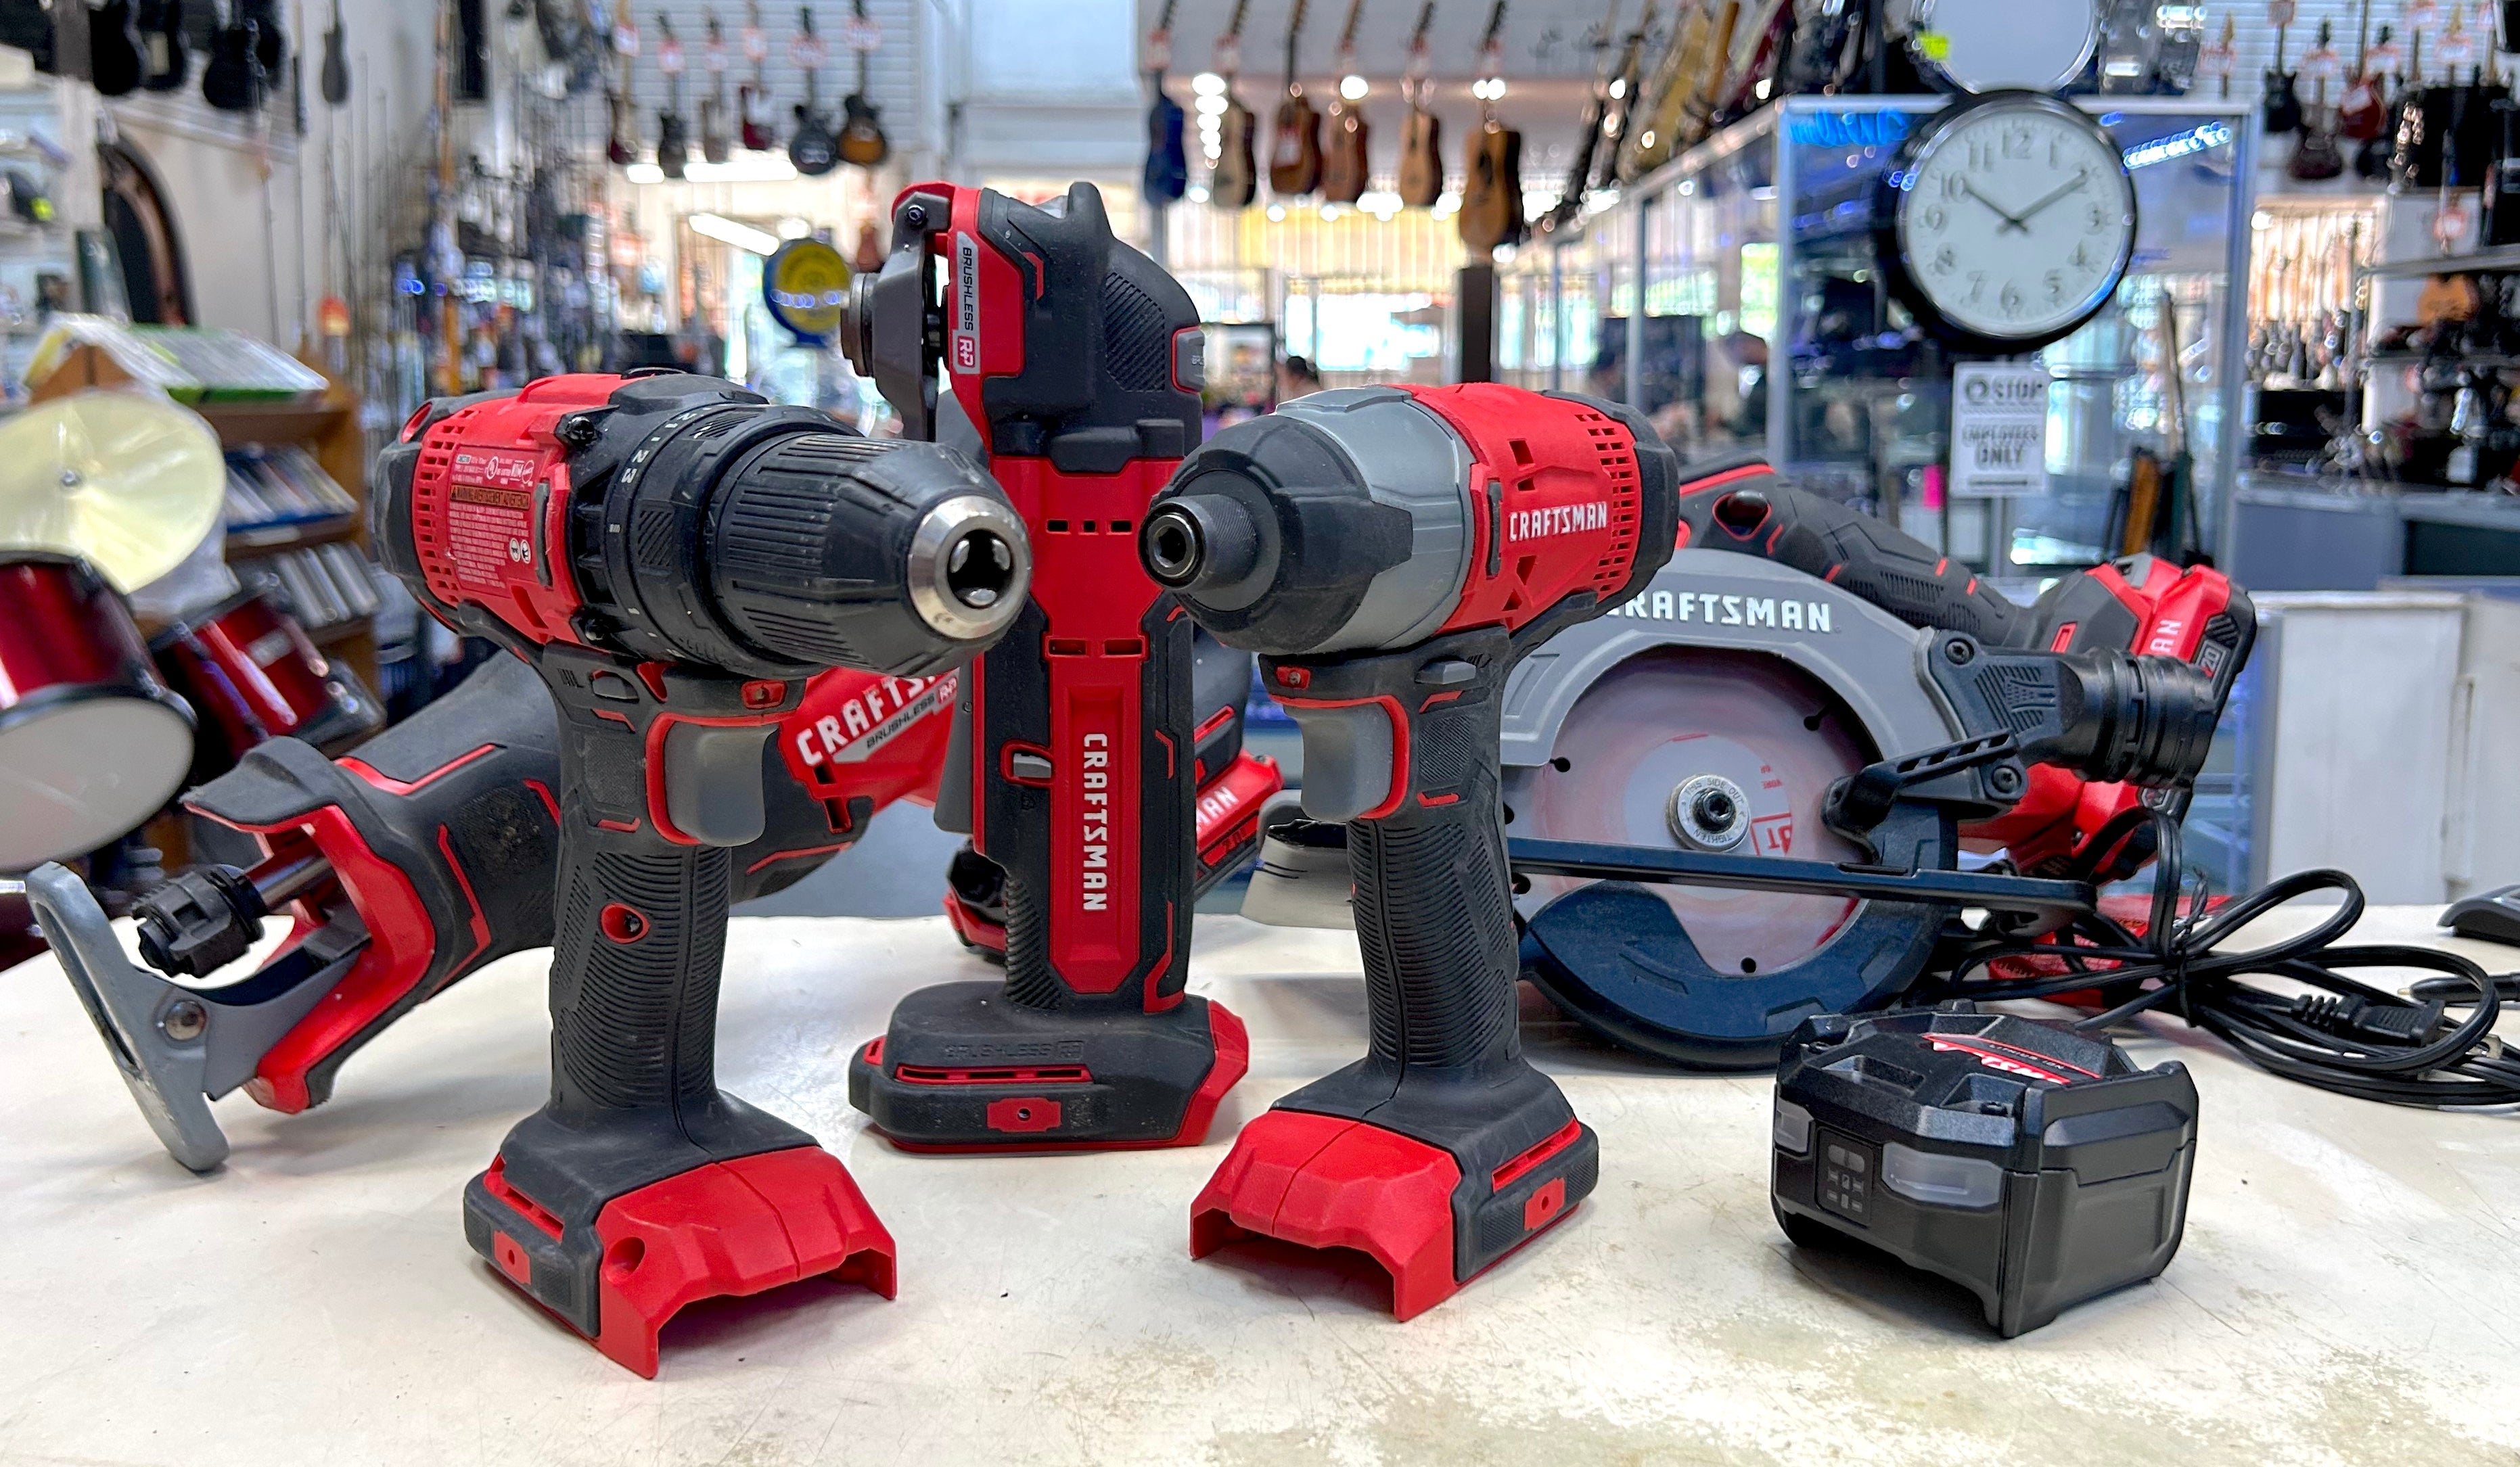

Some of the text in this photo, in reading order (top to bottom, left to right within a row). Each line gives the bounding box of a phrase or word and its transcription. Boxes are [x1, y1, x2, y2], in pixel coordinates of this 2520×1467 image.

[2001, 129, 2034, 160] 12
[961, 246, 974, 331] BRUSHLESS
[1992, 375, 2043, 405] STOP
[1975, 442, 2025, 471] ONLY
[1509, 500, 1607, 542] CRAFTSMAN
[1606, 590, 1831, 633] RAFTSMAN
[796, 675, 936, 767] CRAFTS
[866, 693, 936, 749] BRUSHLESS
[1684, 778, 1745, 805] THIS SIDE OUT
[1082, 732, 1109, 912] CRAFTSMAN
